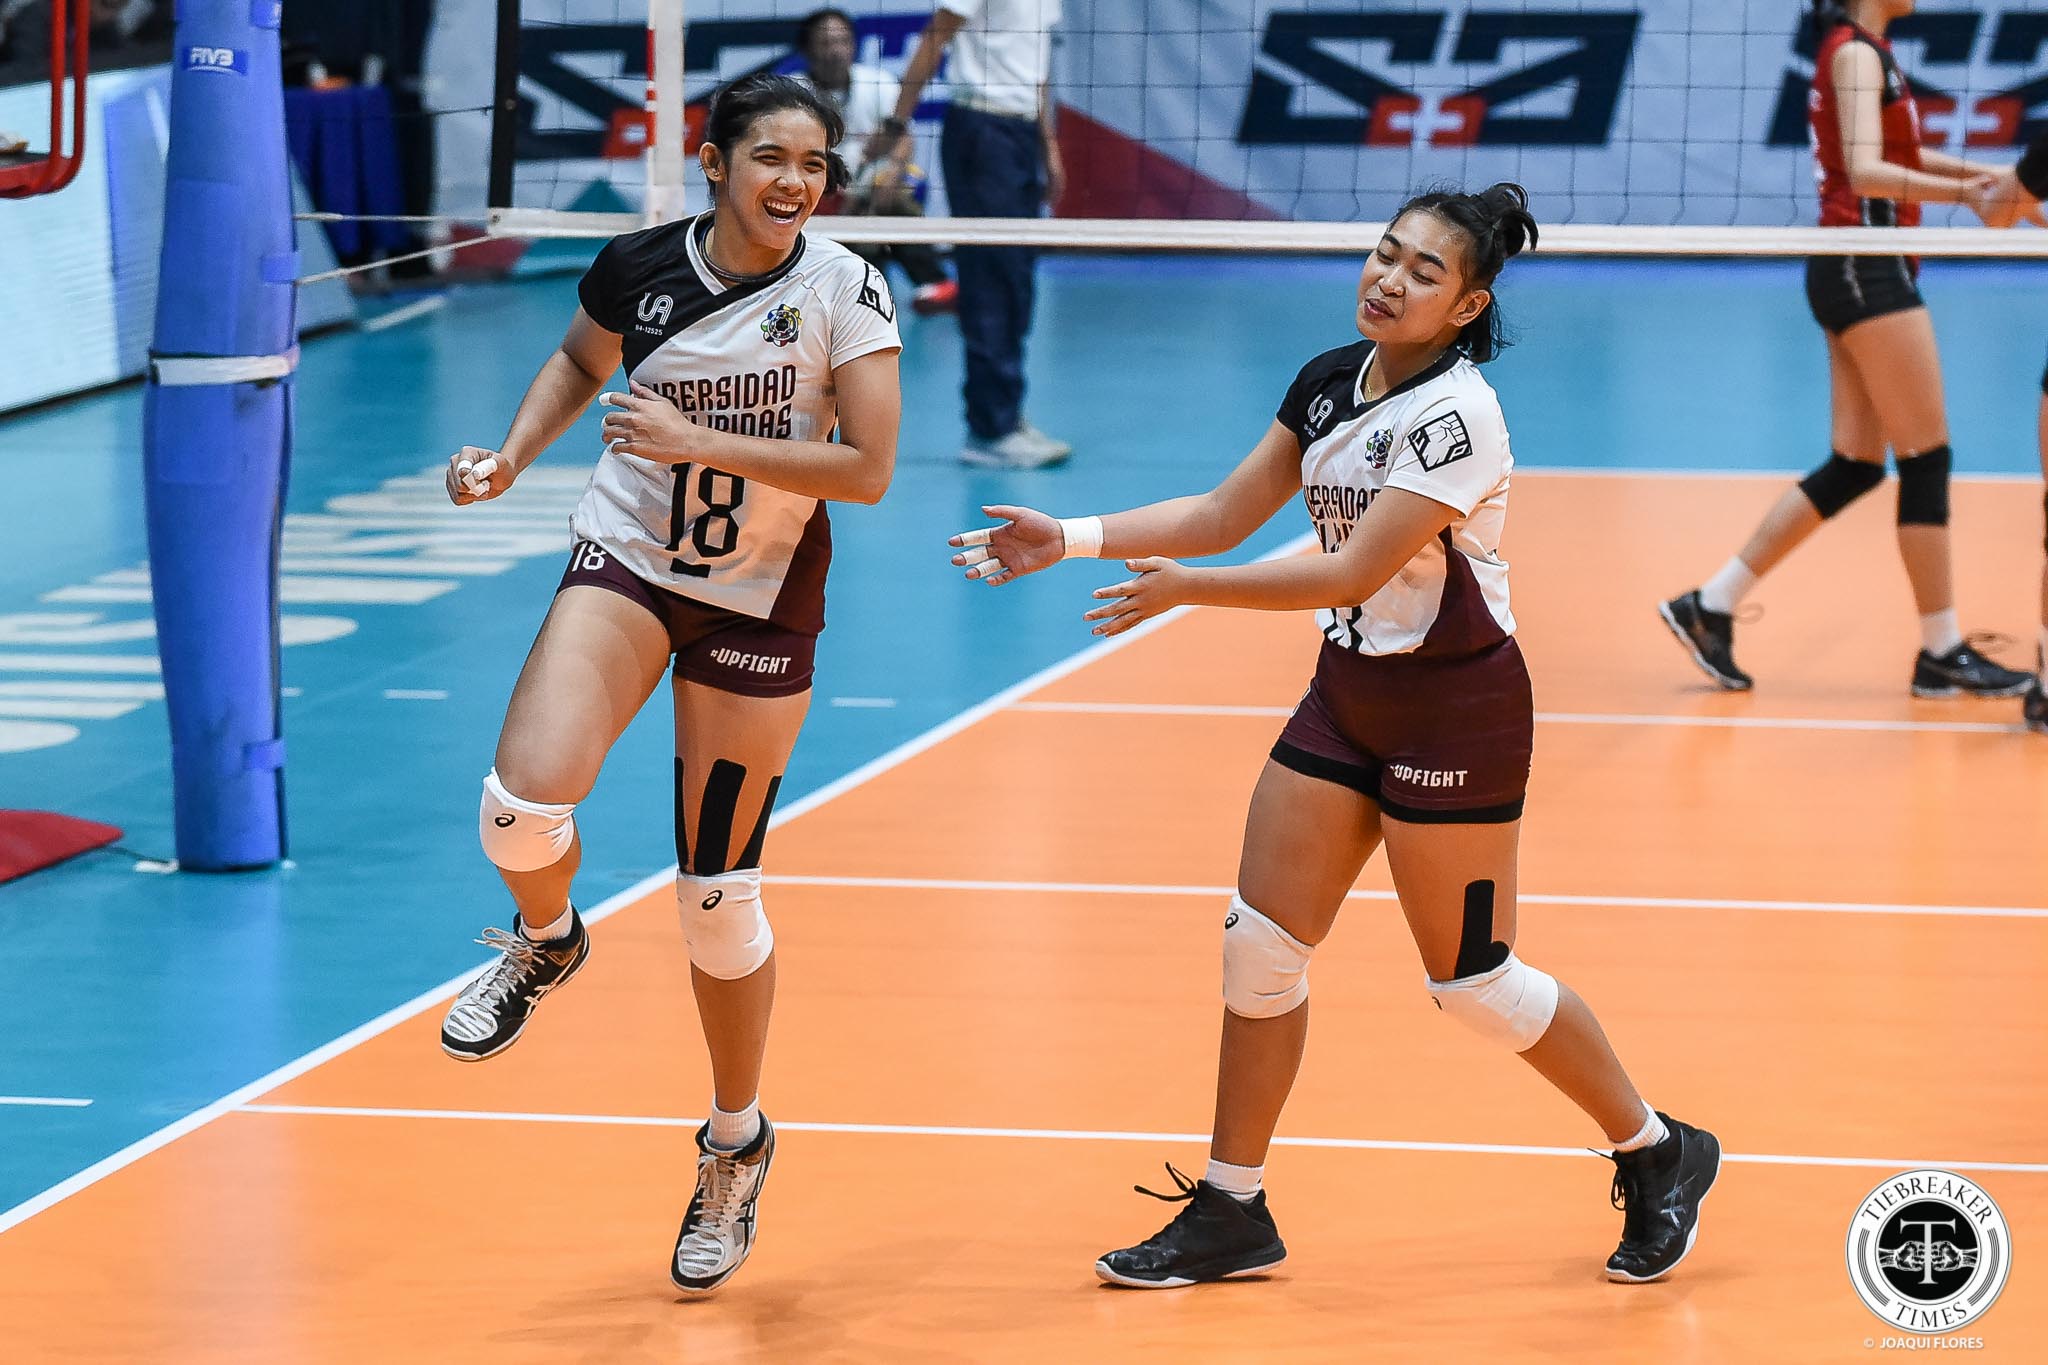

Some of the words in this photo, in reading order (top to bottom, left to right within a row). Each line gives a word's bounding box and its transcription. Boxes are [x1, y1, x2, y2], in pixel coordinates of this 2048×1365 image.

[191, 47, 234, 66] FIVB
[665, 461, 745, 557] 18
[571, 541, 607, 572] 18
[710, 647, 792, 674] #UPFIGHT
